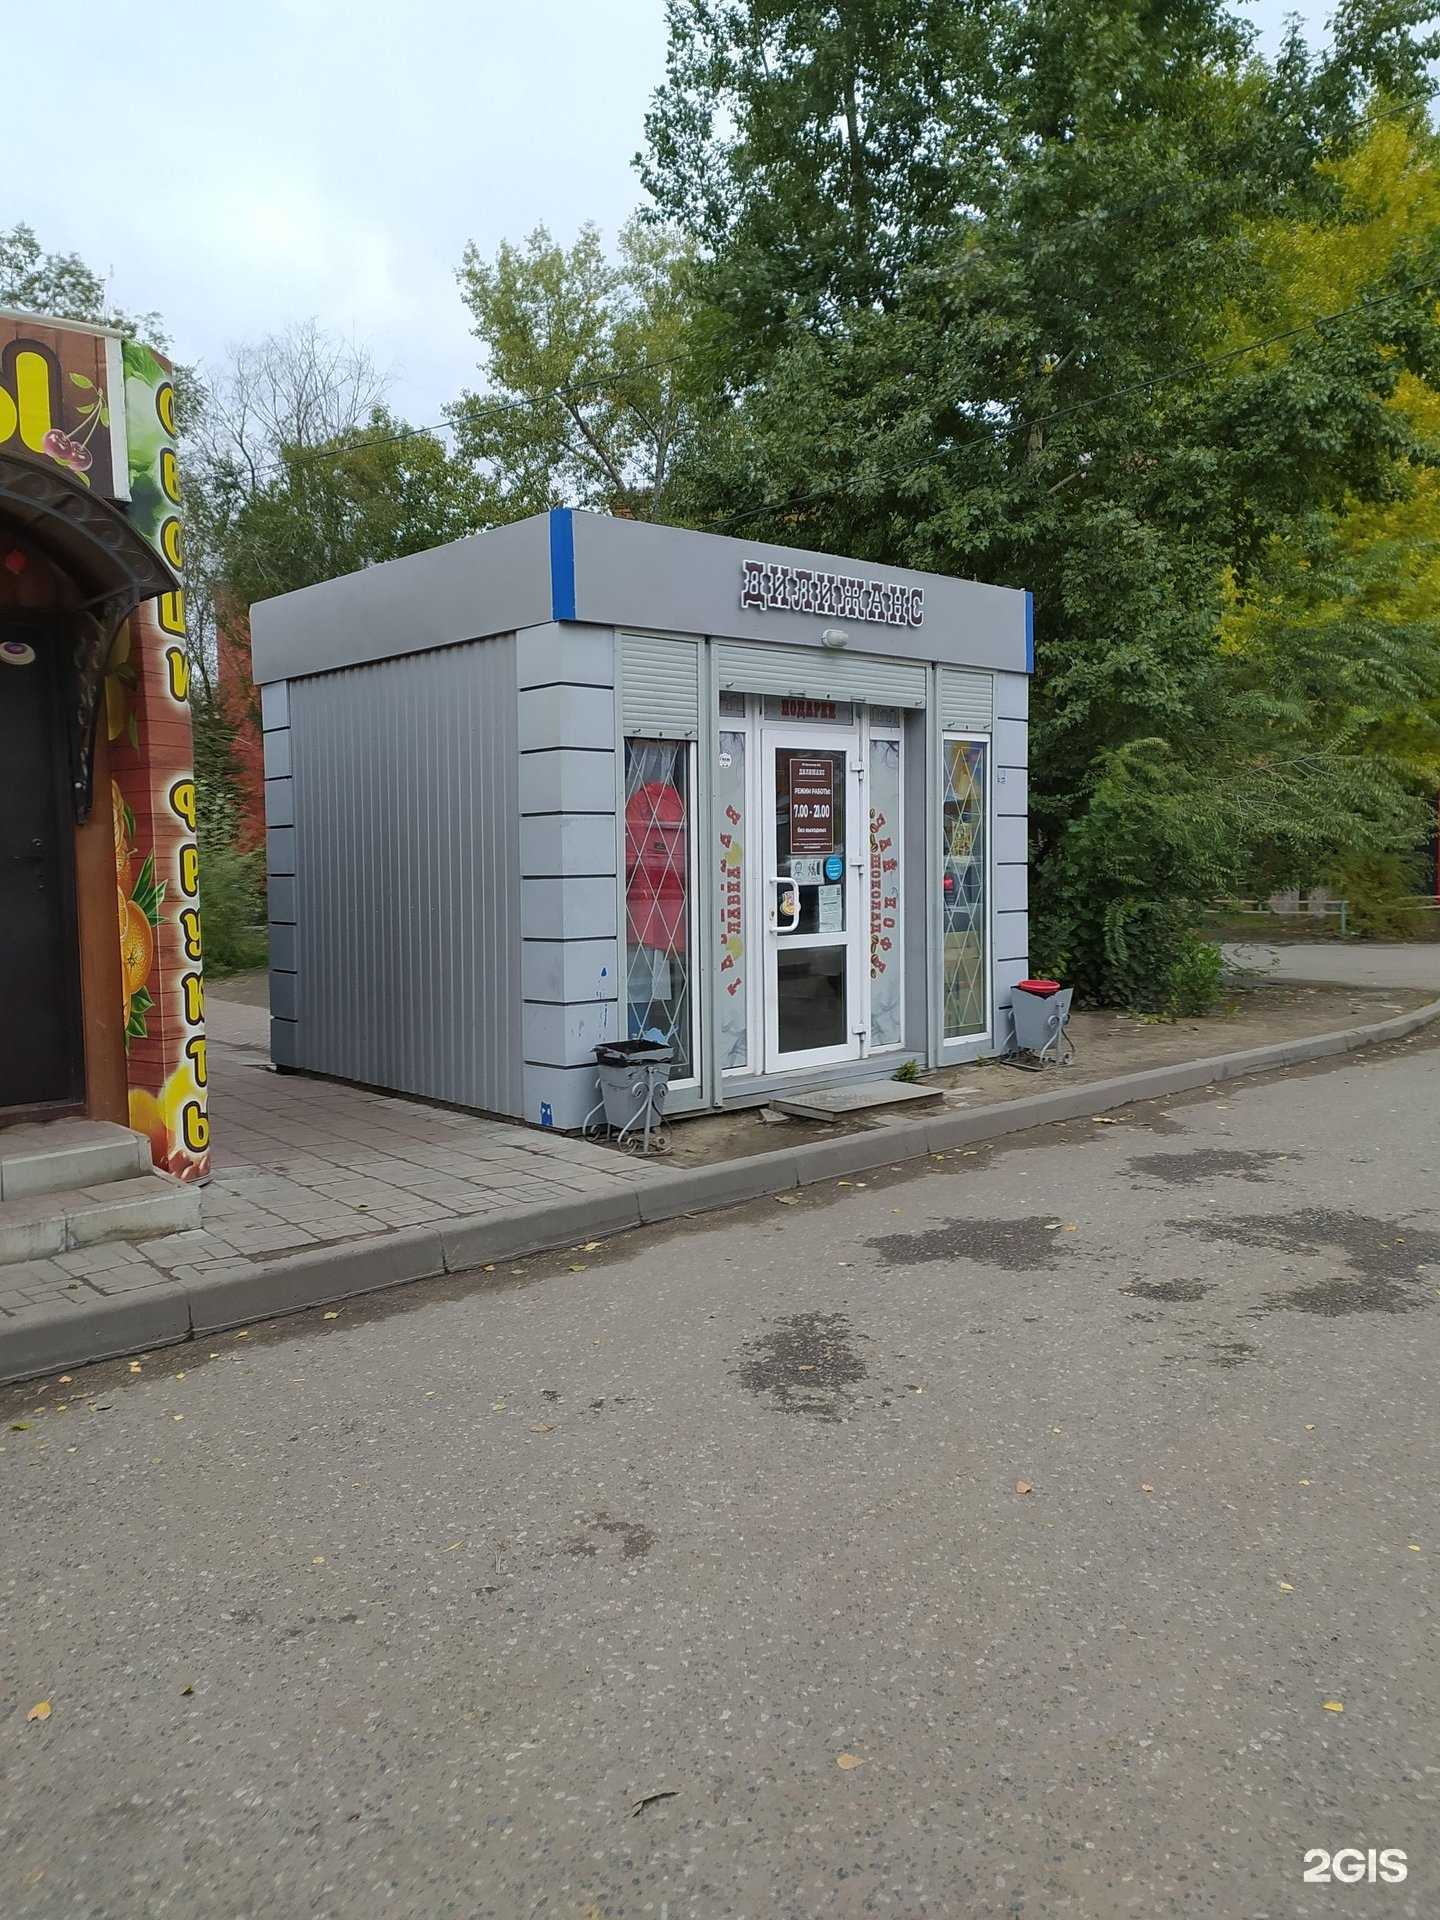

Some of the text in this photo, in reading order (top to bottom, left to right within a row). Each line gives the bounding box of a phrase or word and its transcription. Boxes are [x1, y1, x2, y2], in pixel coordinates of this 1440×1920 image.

[741, 560, 925, 627] ДИЛИЖАНС
[794, 804, 808, 818] 7.00
[814, 804, 830, 818] 21.00
[727, 866, 741, 934] ЛАВКА
[870, 854, 882, 934] ШОКОЛАД
